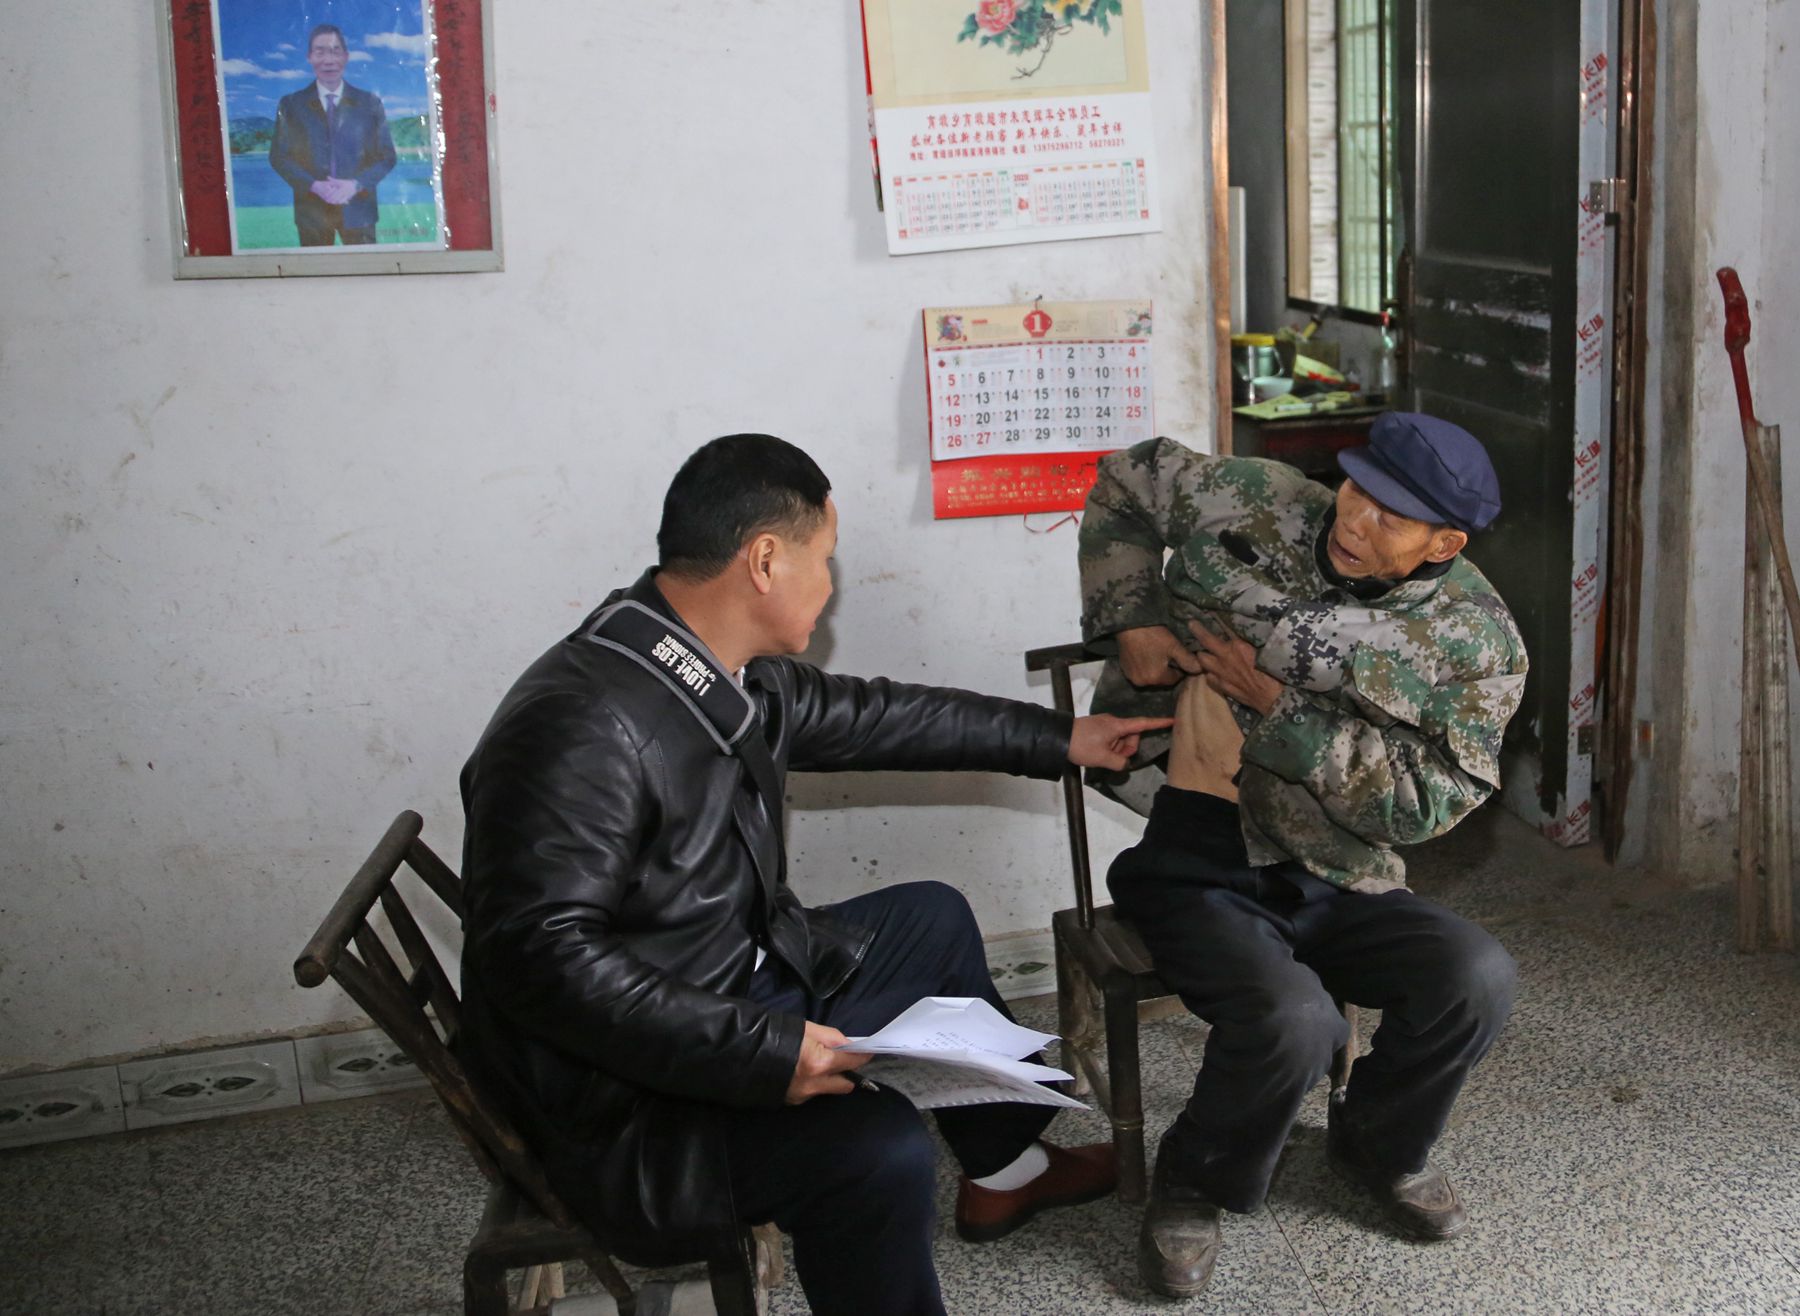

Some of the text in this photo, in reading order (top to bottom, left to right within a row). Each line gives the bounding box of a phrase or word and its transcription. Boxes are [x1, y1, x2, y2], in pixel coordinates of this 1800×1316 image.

[1036, 348, 1043, 360] 1
[1067, 347, 1075, 359] 2
[1098, 346, 1105, 359] 3
[1128, 346, 1137, 358] 4
[948, 366, 1140, 386] 5 6 7 8 9 10 11
[946, 386, 1141, 407] 12 13 14 15 16 17 18
[947, 405, 1142, 427] 19 20 21 22 23 24 25
[947, 425, 1110, 448] 26 27 28 29 30 31
[662, 634, 711, 677] PROFESSIONAL
[651, 641, 711, 696] I LOVE EOS
